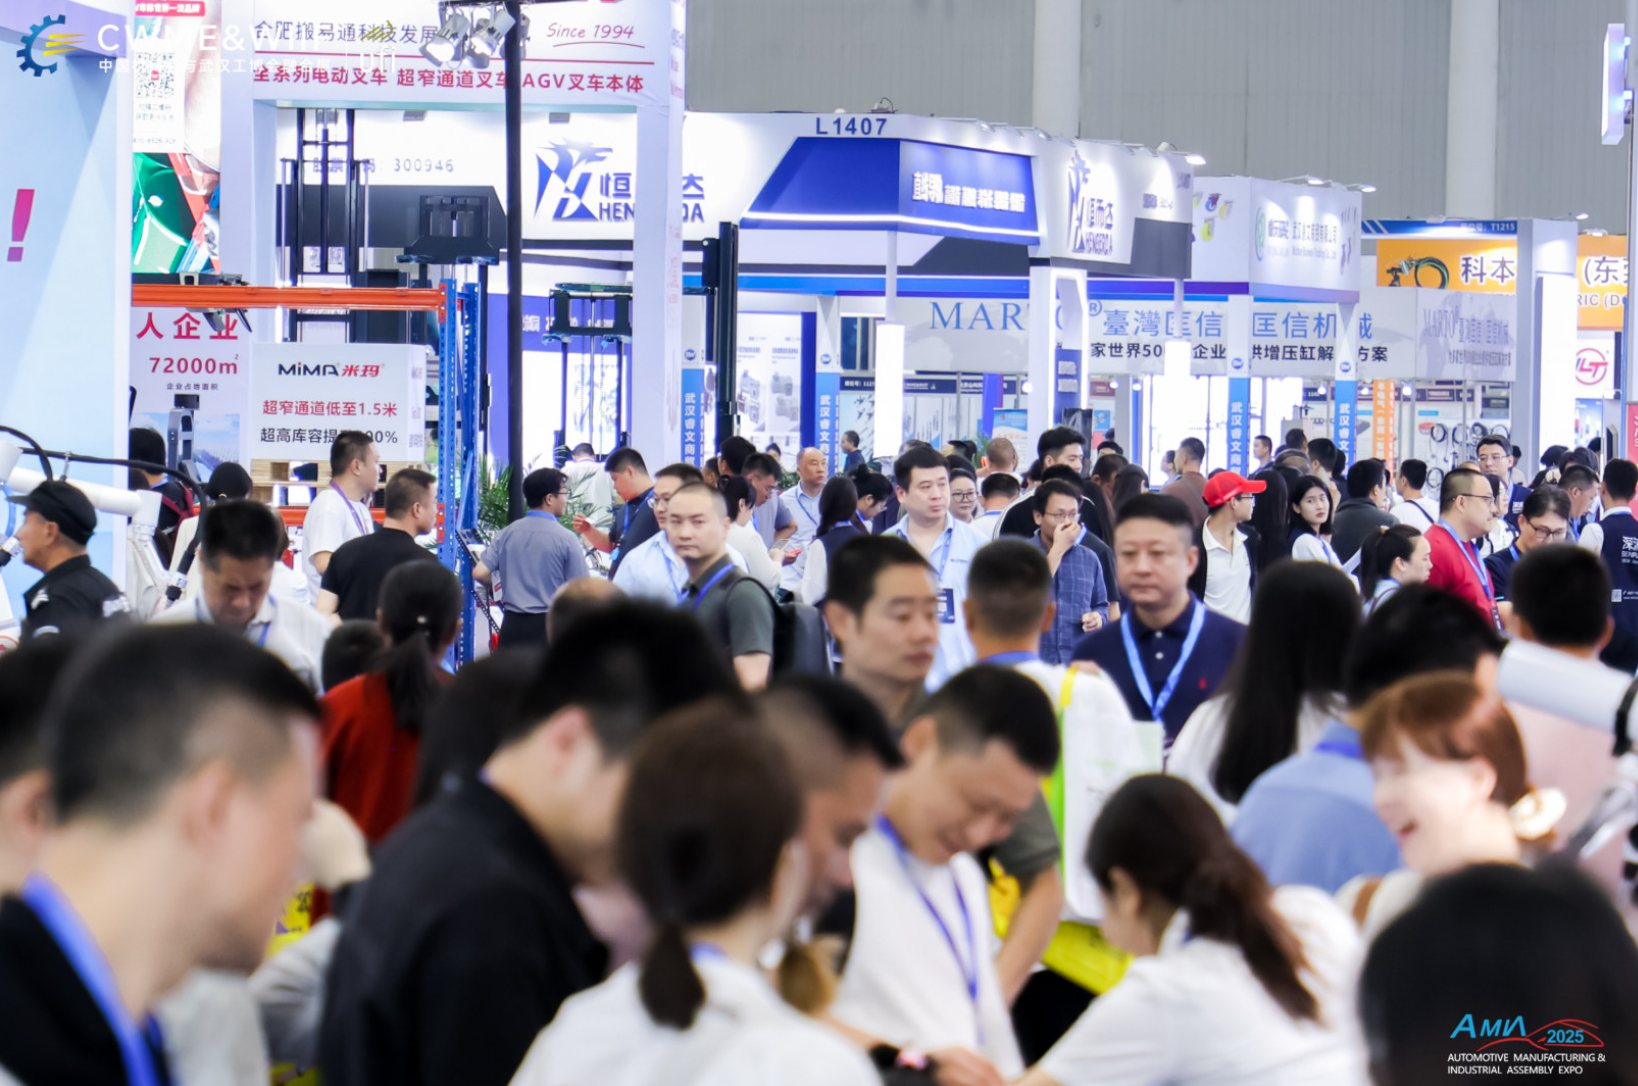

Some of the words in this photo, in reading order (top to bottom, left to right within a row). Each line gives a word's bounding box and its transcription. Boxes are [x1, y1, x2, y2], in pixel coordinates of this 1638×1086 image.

[546, 22, 586, 38] Since
[594, 24, 634, 39] 1994
[253, 65, 388, 86] 全系列电动叉车
[397, 67, 507, 89] 超窄通道叉车
[522, 73, 644, 93] AGV叉车本体
[815, 117, 887, 136] L1407
[394, 158, 454, 173] 300946
[1491, 223, 1515, 232] T1215
[1461, 256, 1515, 284] 科本
[166, 382, 218, 391] 企业占地面积
[262, 400, 398, 418] 超窄通道低至1.5米
